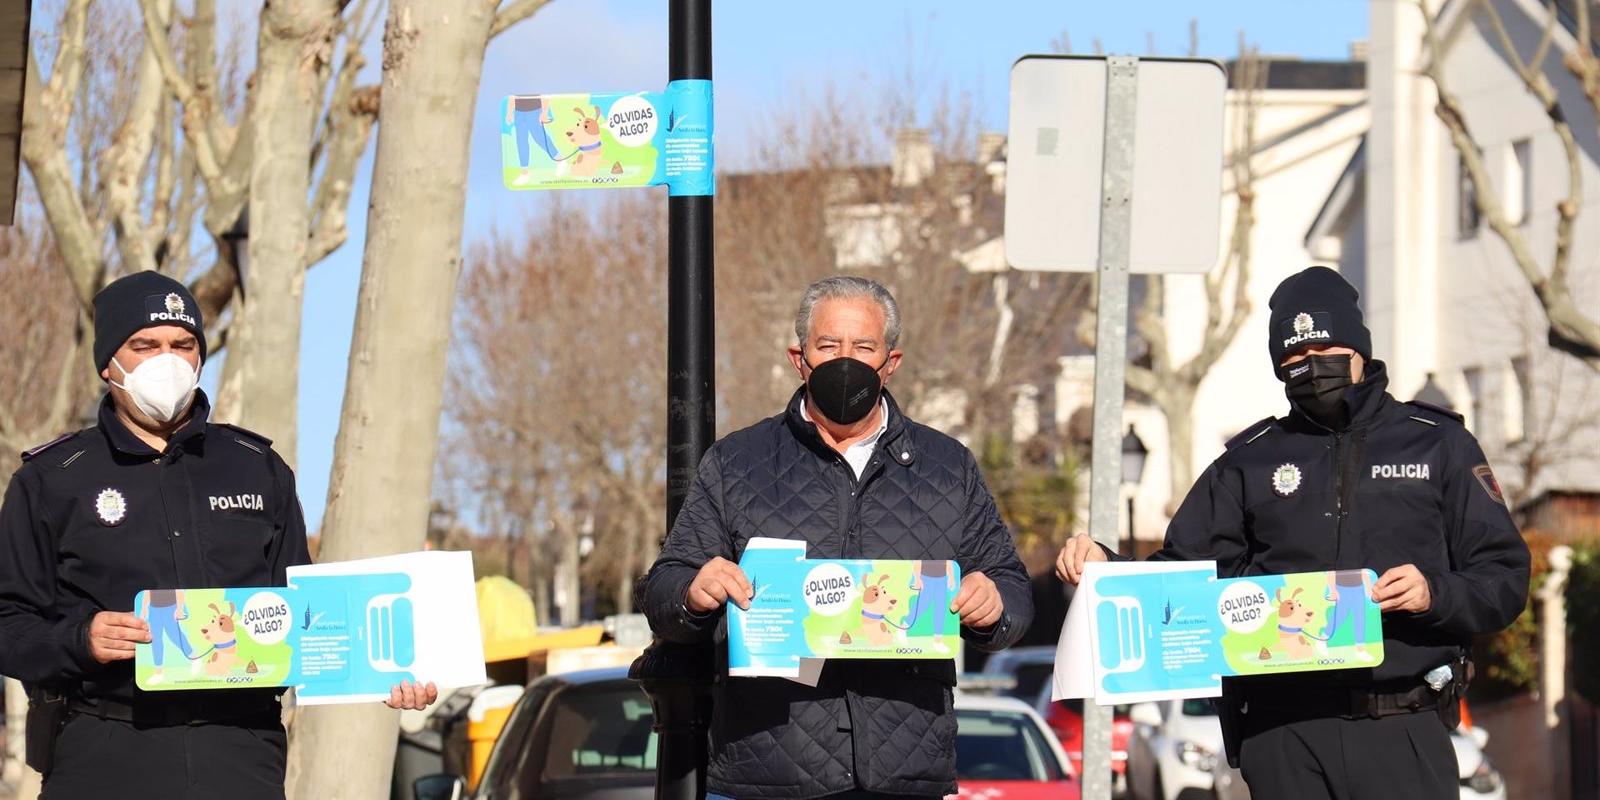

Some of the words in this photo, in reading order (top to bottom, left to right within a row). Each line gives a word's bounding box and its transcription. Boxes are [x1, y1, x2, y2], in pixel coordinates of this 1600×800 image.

[609, 107, 653, 128] ¿OLVIDAS
[619, 122, 649, 138] ALGO?
[150, 312, 196, 327] POLICIA
[1283, 330, 1331, 348] POLICIA
[1371, 463, 1430, 480] POLICIA
[208, 494, 264, 511] POLICIA
[805, 576, 851, 596] ¿OLVIDAS
[815, 590, 846, 606] ALGO?
[1220, 592, 1266, 616] ¿OLVIDAS
[243, 604, 287, 625] ¿OLVIDAS
[1231, 608, 1262, 625] ALGO?
[253, 619, 283, 636] ALGO?
